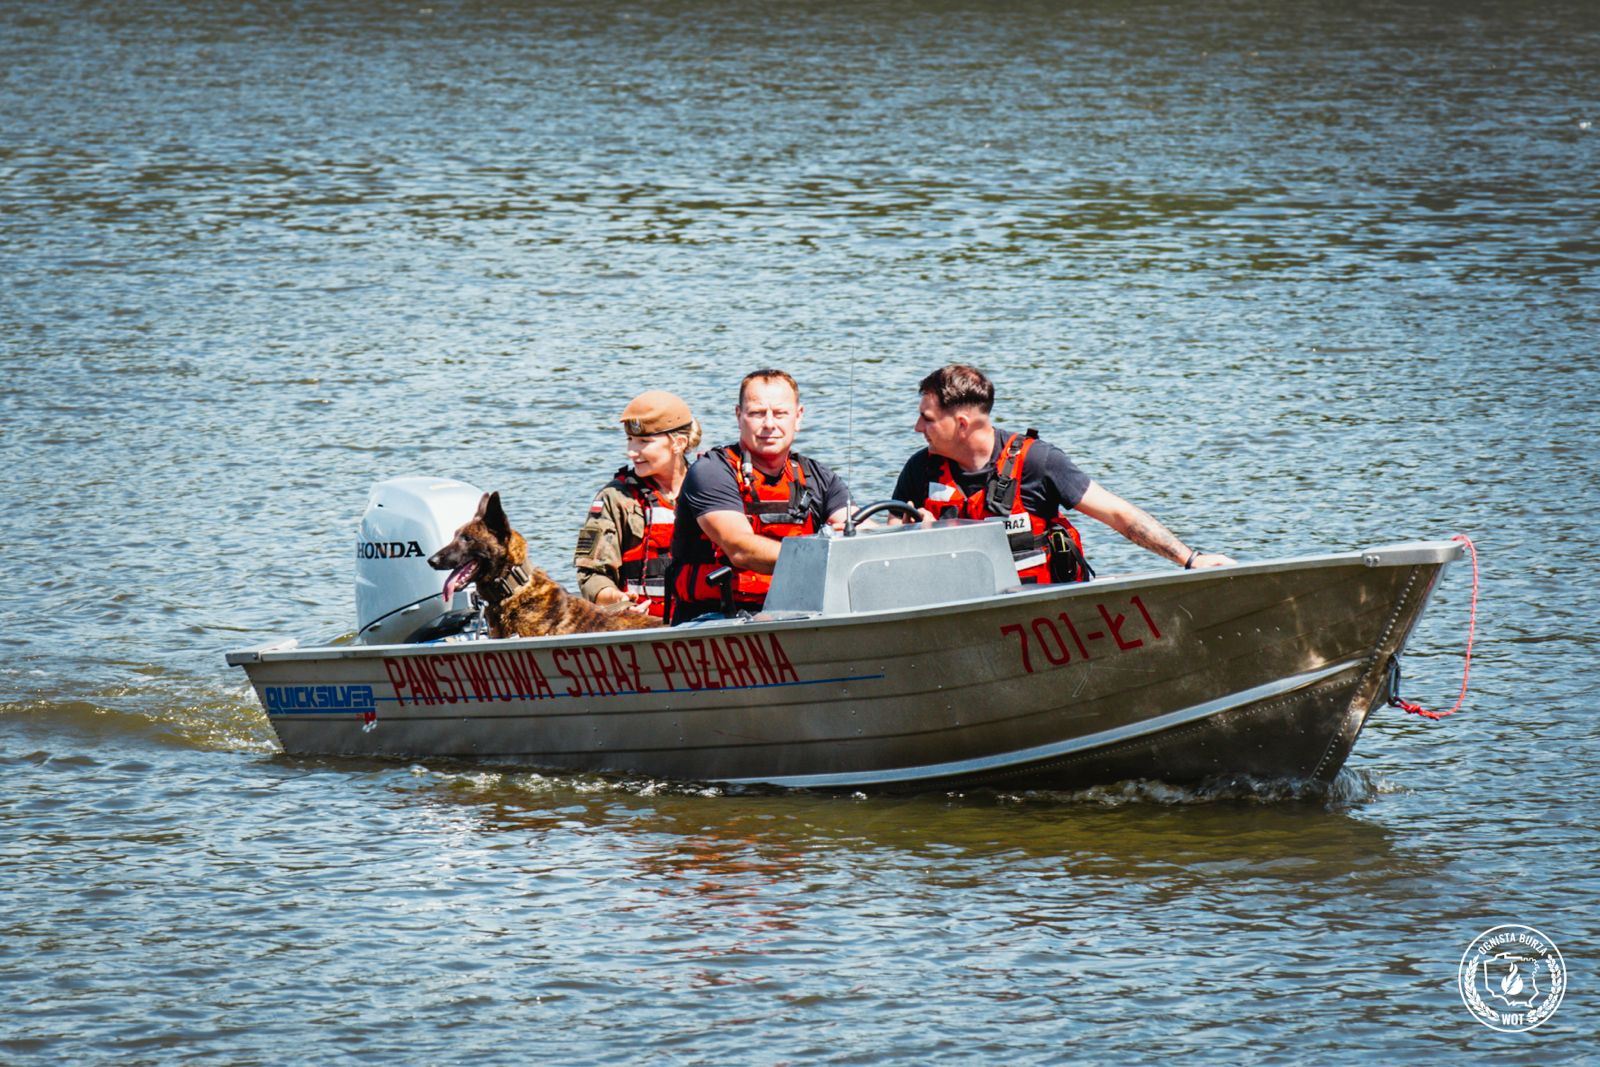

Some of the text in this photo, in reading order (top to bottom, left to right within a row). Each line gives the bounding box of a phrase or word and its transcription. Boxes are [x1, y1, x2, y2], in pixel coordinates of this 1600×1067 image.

[1003, 518, 1025, 530] RAŻ
[357, 541, 425, 559] HONDA
[1000, 595, 1161, 672] 701-Ł1
[552, 644, 650, 698] STRAŻ
[652, 632, 799, 691] POŻARNA
[265, 685, 376, 714] QUICKSILVER
